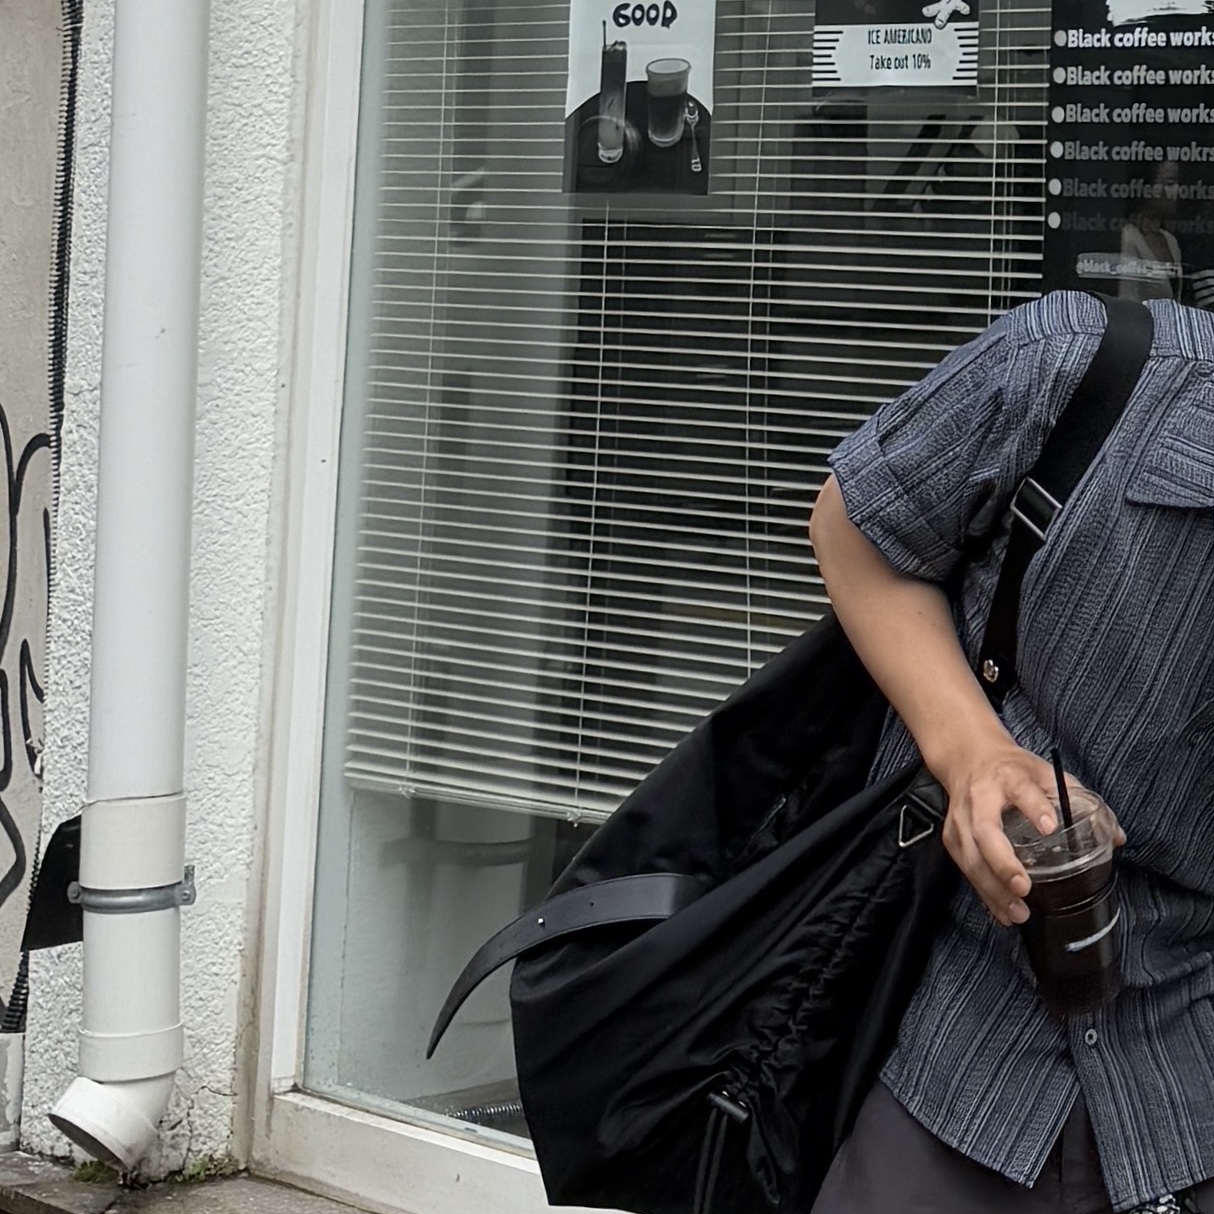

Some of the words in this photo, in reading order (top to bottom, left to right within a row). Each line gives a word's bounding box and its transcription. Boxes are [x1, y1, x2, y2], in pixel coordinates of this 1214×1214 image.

[612, 0, 678, 29] GOOD
[868, 29, 881, 45] ICE
[1067, 28, 1111, 48] Black
[1113, 27, 1166, 47] coffee
[870, 54, 892, 70] Take
[894, 54, 909, 70] out
[912, 53, 931, 70] 10%
[1066, 65, 1111, 86] Black
[1113, 64, 1166, 85] coffee
[1065, 103, 1110, 123] Black
[1112, 102, 1165, 123] coffee
[1064, 140, 1109, 160] Black
[1111, 141, 1164, 161] coffee
[1062, 178, 1108, 198] Black
[1109, 178, 1163, 199] coffee
[1061, 211, 1107, 231] Black
